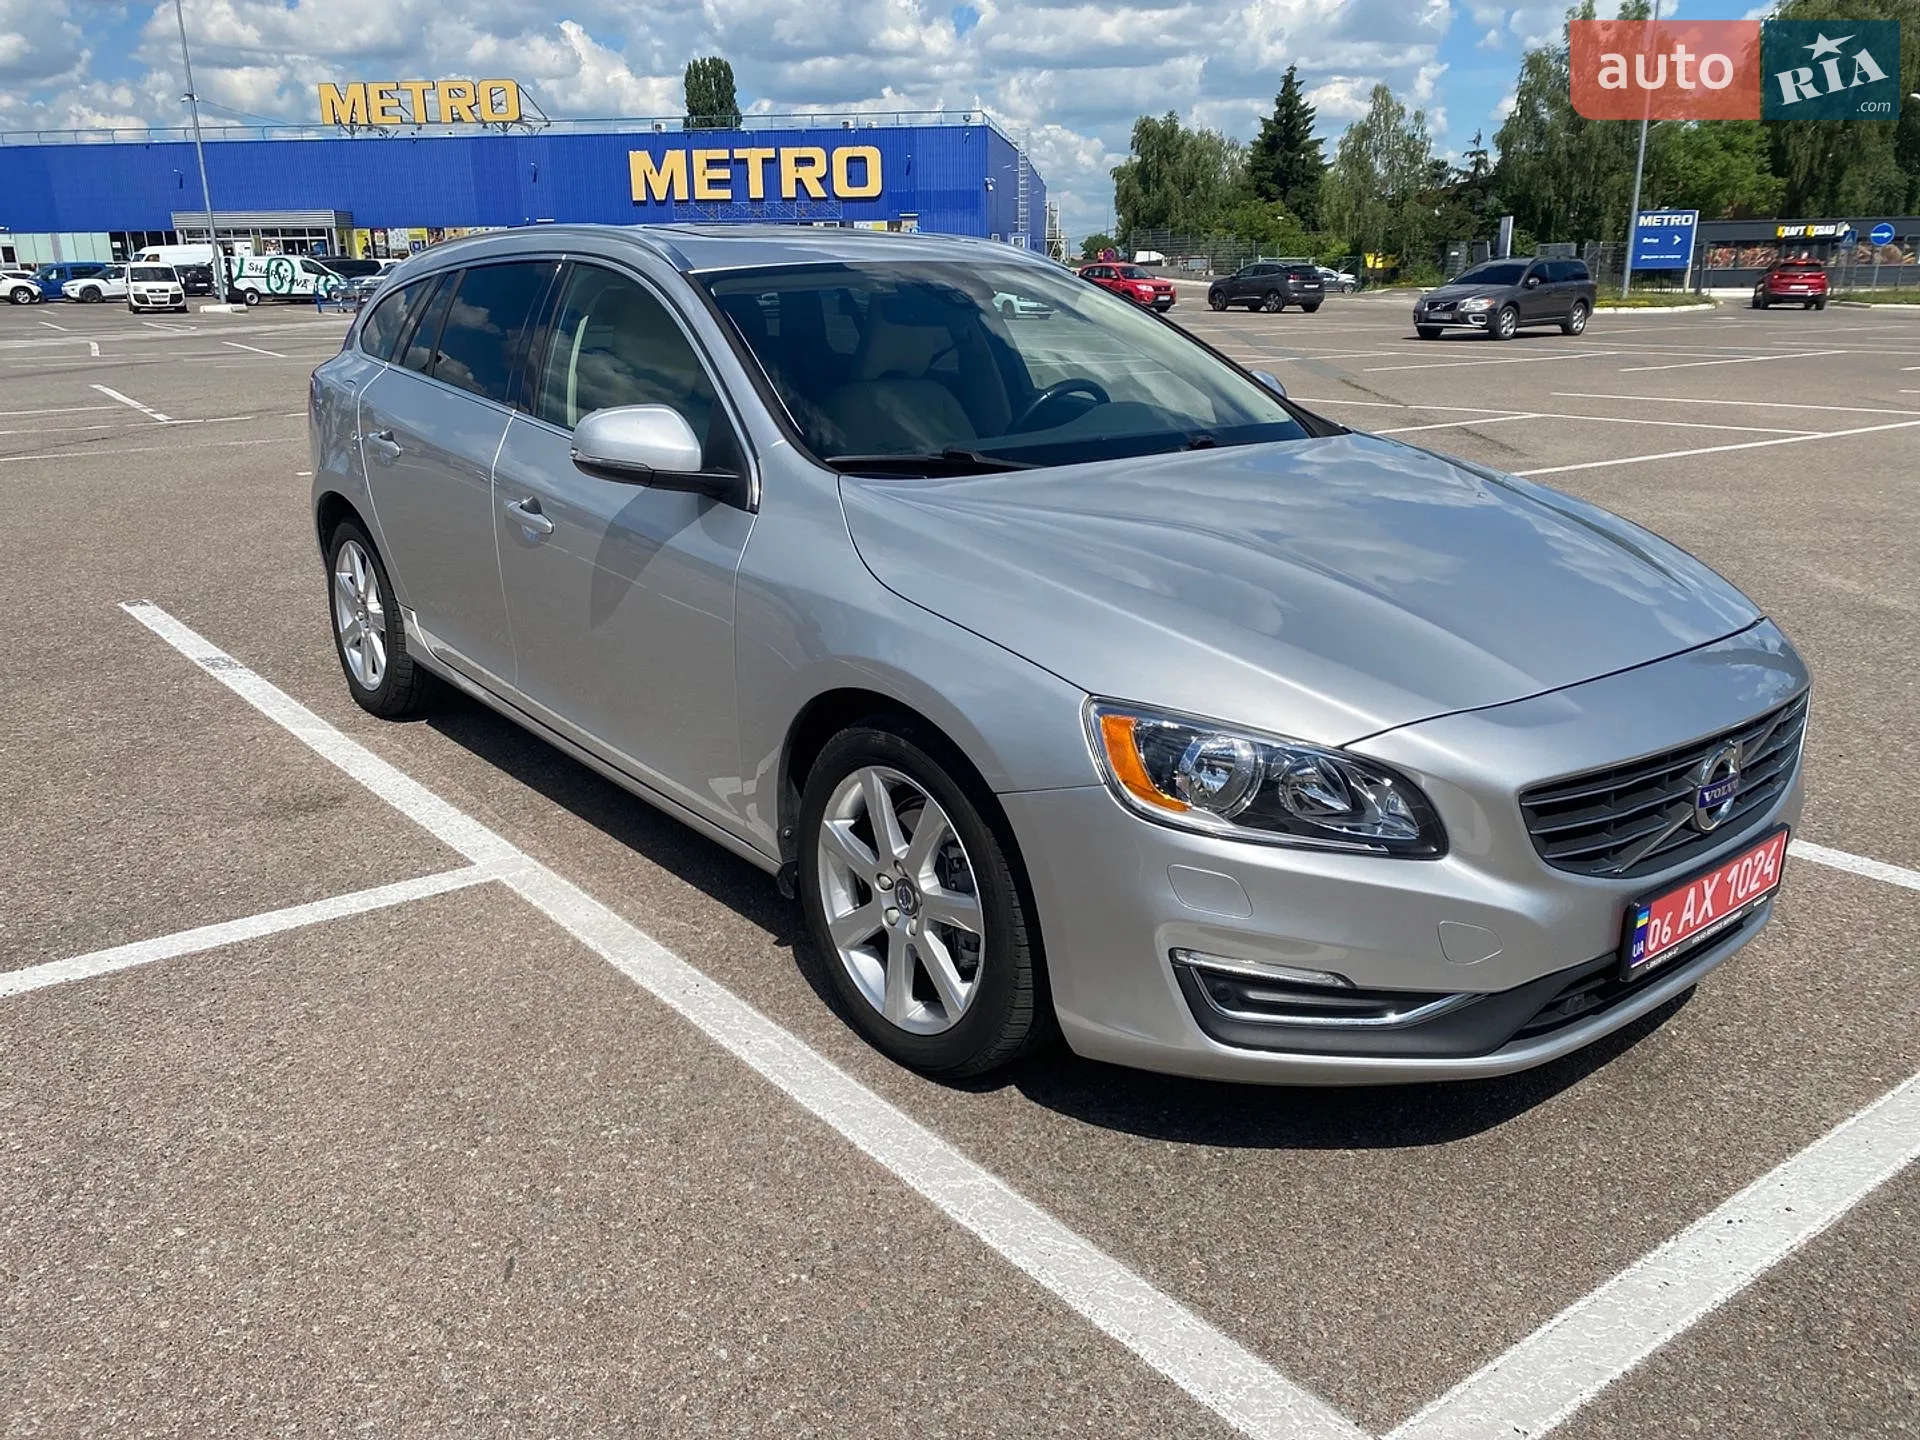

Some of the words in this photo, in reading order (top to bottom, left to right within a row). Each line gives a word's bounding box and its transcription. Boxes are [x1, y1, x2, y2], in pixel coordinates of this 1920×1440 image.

[318, 79, 520, 125] METRO
[629, 146, 882, 201] METRO
[1638, 214, 1693, 227] METRO
[1703, 779, 1739, 802] VOLVO
[1648, 911, 1674, 952] 06
[1677, 872, 1722, 935] AX
[1726, 841, 1779, 906] 1024
[1632, 940, 1645, 958] UA
